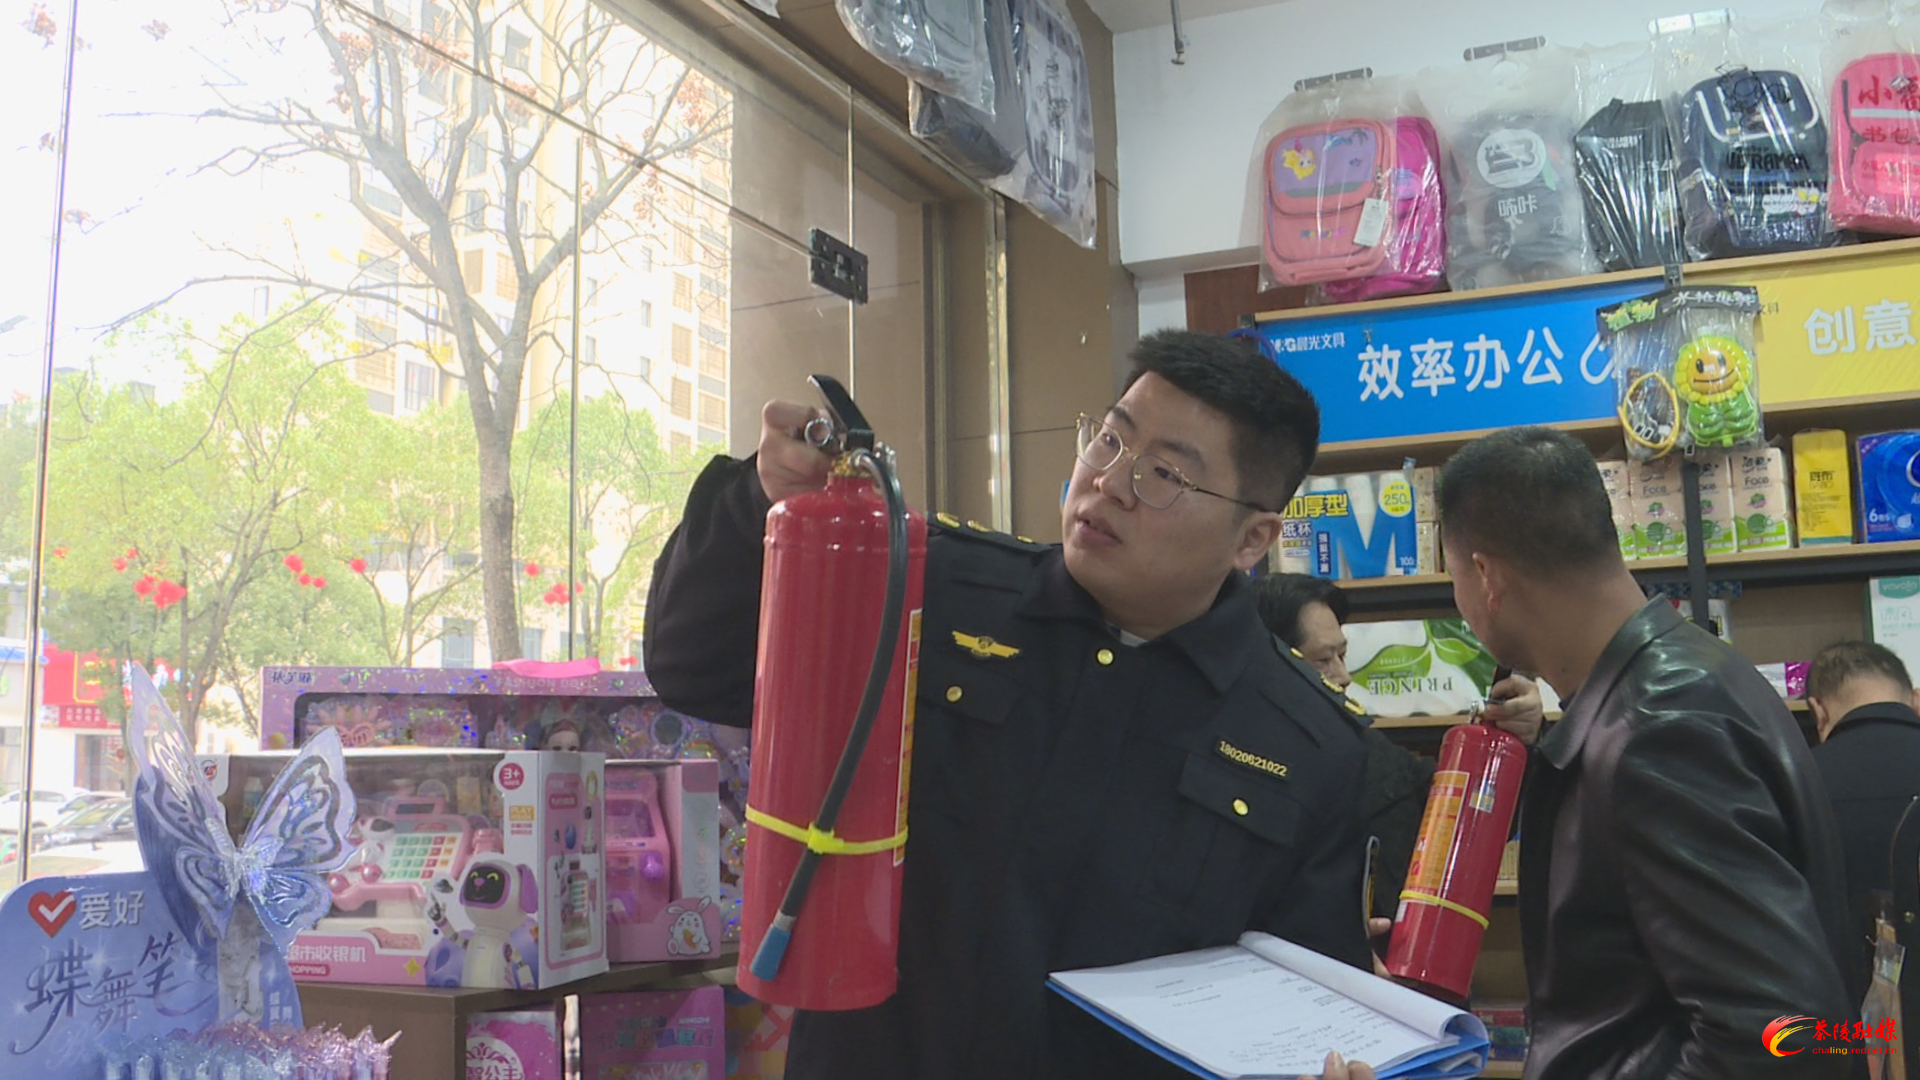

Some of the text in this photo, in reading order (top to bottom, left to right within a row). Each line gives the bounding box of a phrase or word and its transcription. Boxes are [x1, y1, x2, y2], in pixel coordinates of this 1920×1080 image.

[1804, 298, 1917, 356] 创意
[1357, 326, 1565, 401] 效率办公
[1368, 676, 1453, 696] PRINCE
[79, 890, 145, 930] 爱好
